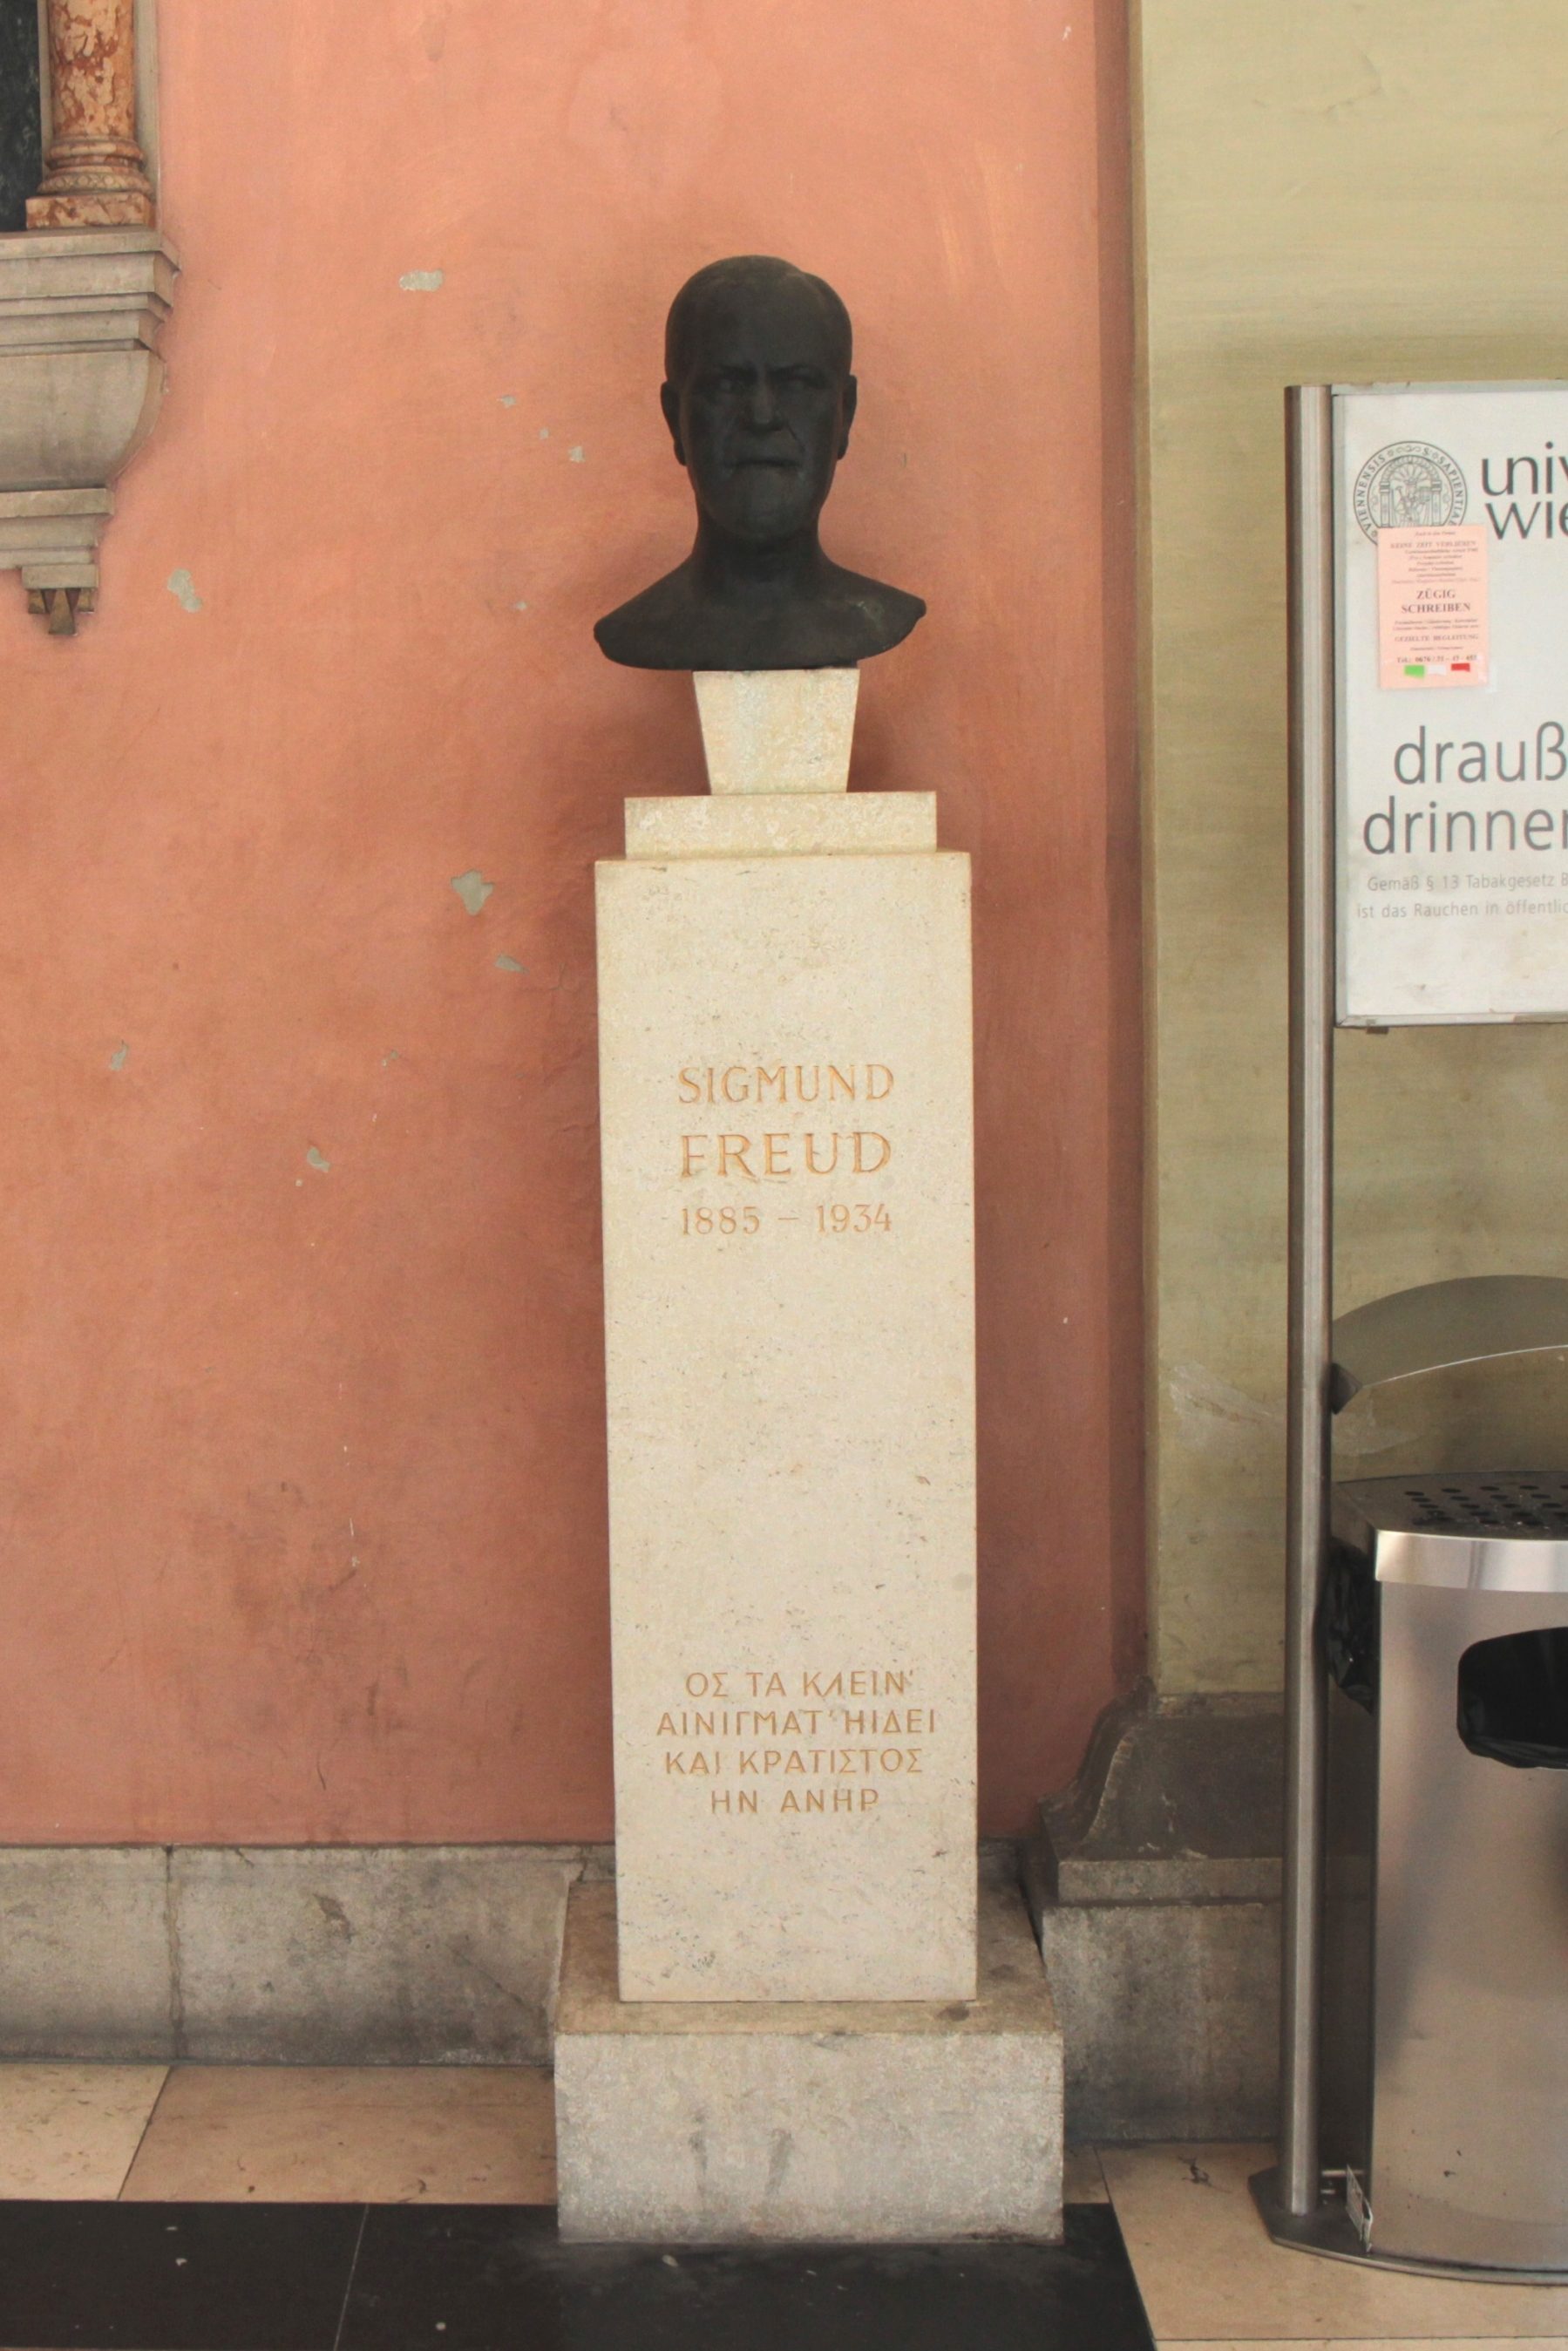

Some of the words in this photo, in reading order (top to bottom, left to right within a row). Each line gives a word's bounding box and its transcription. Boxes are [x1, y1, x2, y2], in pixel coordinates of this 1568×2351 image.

[1356, 453, 1386, 532] VIENNENSIS
[1401, 602, 1471, 614] SCHREIBEN
[1416, 588, 1456, 600] ZÜGIG
[1395, 721, 1568, 785] drauß
[1363, 795, 1568, 855] drinne
[1367, 875, 1420, 892] Gemäß
[1442, 874, 1459, 889] 13
[1466, 873, 1555, 891] Tabakgesetz
[1357, 903, 1375, 919] ist
[1381, 903, 1408, 918] das
[1414, 901, 1478, 917] Rauchen
[1485, 900, 1499, 915] in
[678, 1063, 895, 1104] SIGMUND
[680, 1131, 893, 1182] FREUD
[681, 1205, 761, 1235] 1885
[817, 1202, 893, 1233] 1934
[685, 1671, 729, 1698] ΟΣ
[746, 1671, 787, 1697] ΤΑ
[665, 1750, 721, 1775] ΚΑΙ
[738, 1748, 924, 1776] ΚΡΑΤΙΣΤΟΣ
[710, 1789, 758, 1814] ΗΝ
[780, 1788, 879, 1813] ΑΝΗΡ
